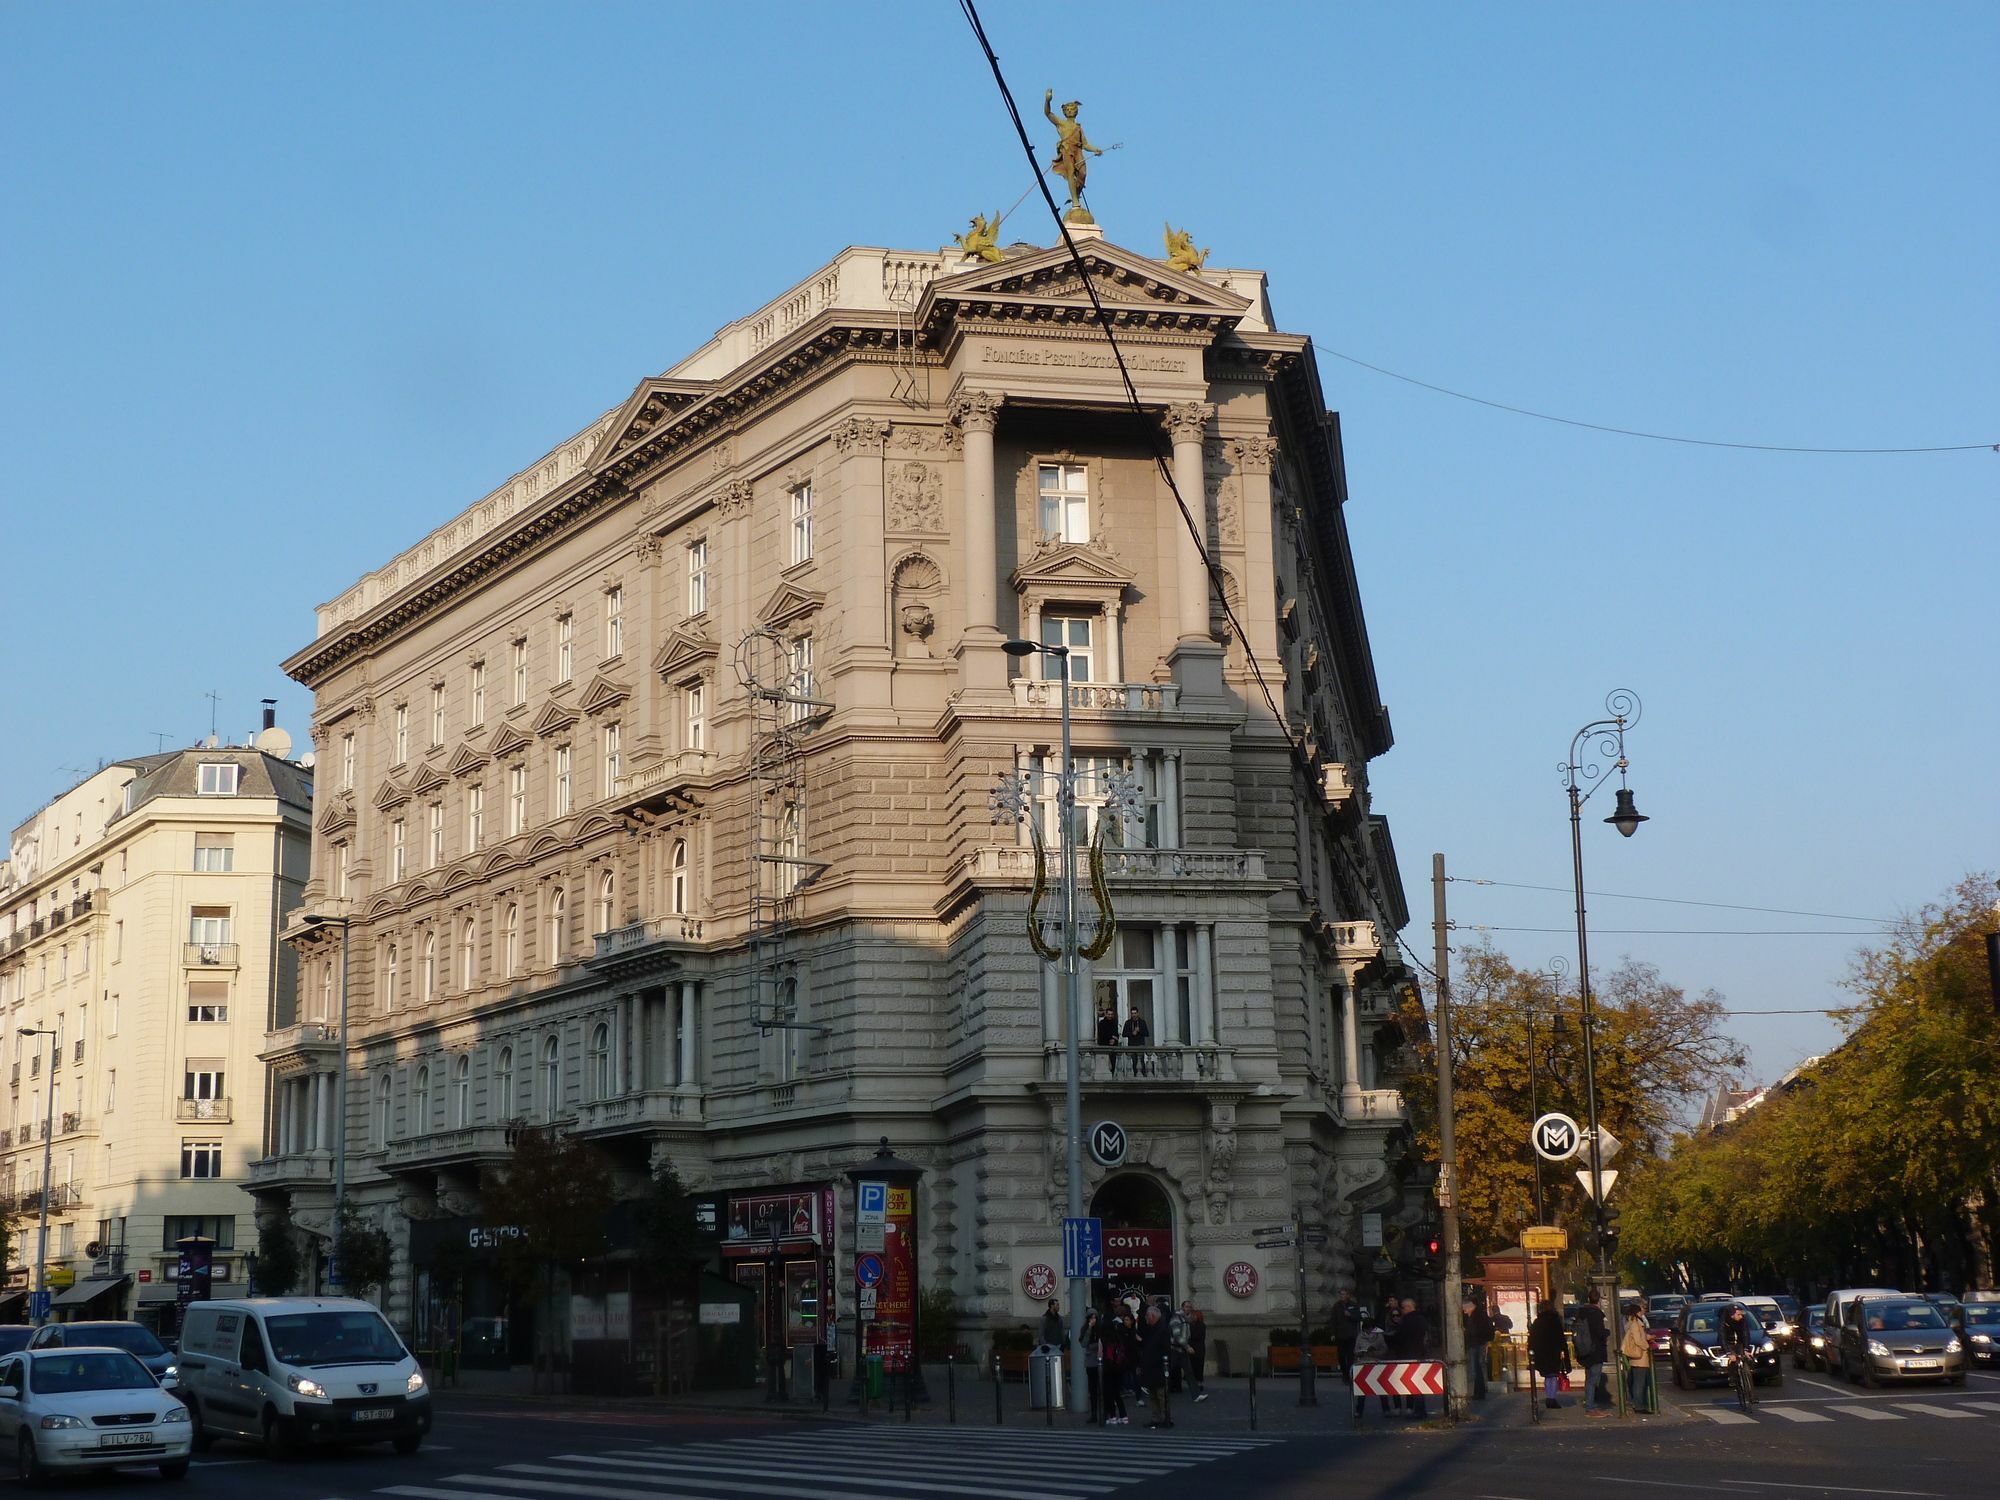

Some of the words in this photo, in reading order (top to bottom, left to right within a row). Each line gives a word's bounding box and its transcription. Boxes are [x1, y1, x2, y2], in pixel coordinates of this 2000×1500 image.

[1042, 349, 1078, 367] PESTI
[1139, 354, 1187, 372] INTÉZET
[825, 1193, 833, 1214] NON
[866, 1188, 881, 1209] P
[887, 1201, 908, 1210] OFF
[1108, 1236, 1150, 1248] COSTA
[1106, 1258, 1153, 1268] COFFEE
[1029, 1266, 1050, 1276] COSTA
[1230, 1265, 1251, 1275] COSTA
[1028, 1283, 1053, 1296] COFFEE
[1229, 1282, 1255, 1294] COFFEE
[111, 1434, 150, 1444] ILV-784
